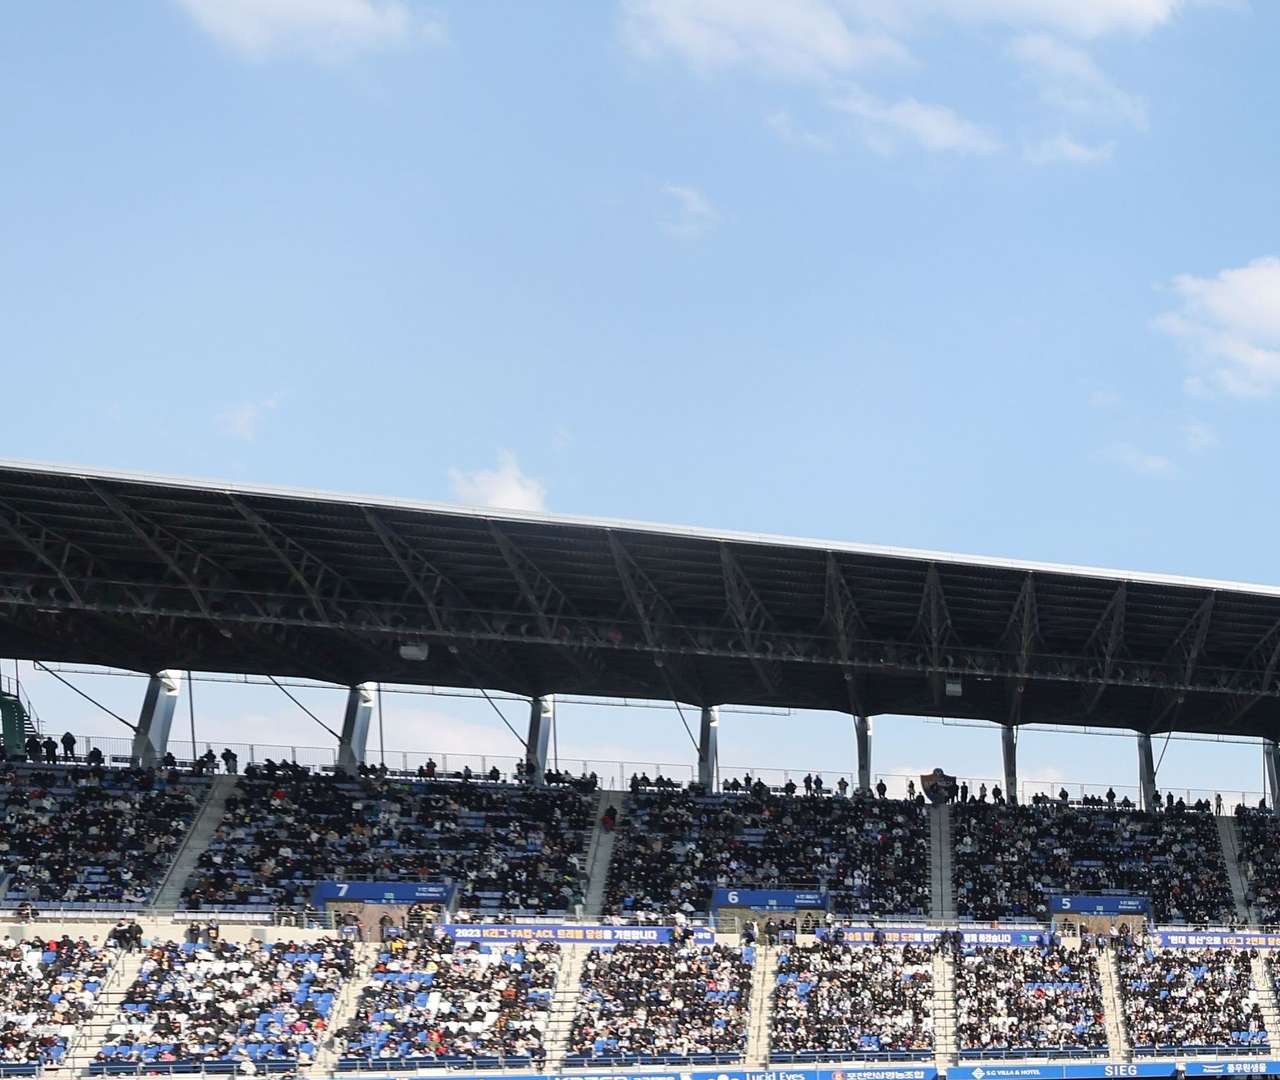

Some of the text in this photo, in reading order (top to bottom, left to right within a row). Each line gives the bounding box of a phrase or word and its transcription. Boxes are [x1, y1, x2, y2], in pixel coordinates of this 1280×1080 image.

[336, 884, 349, 897] 7
[727, 891, 740, 904] 6
[1061, 897, 1072, 910] 5
[455, 929, 481, 938] 2023
[1104, 1065, 1138, 1077] SIEG
